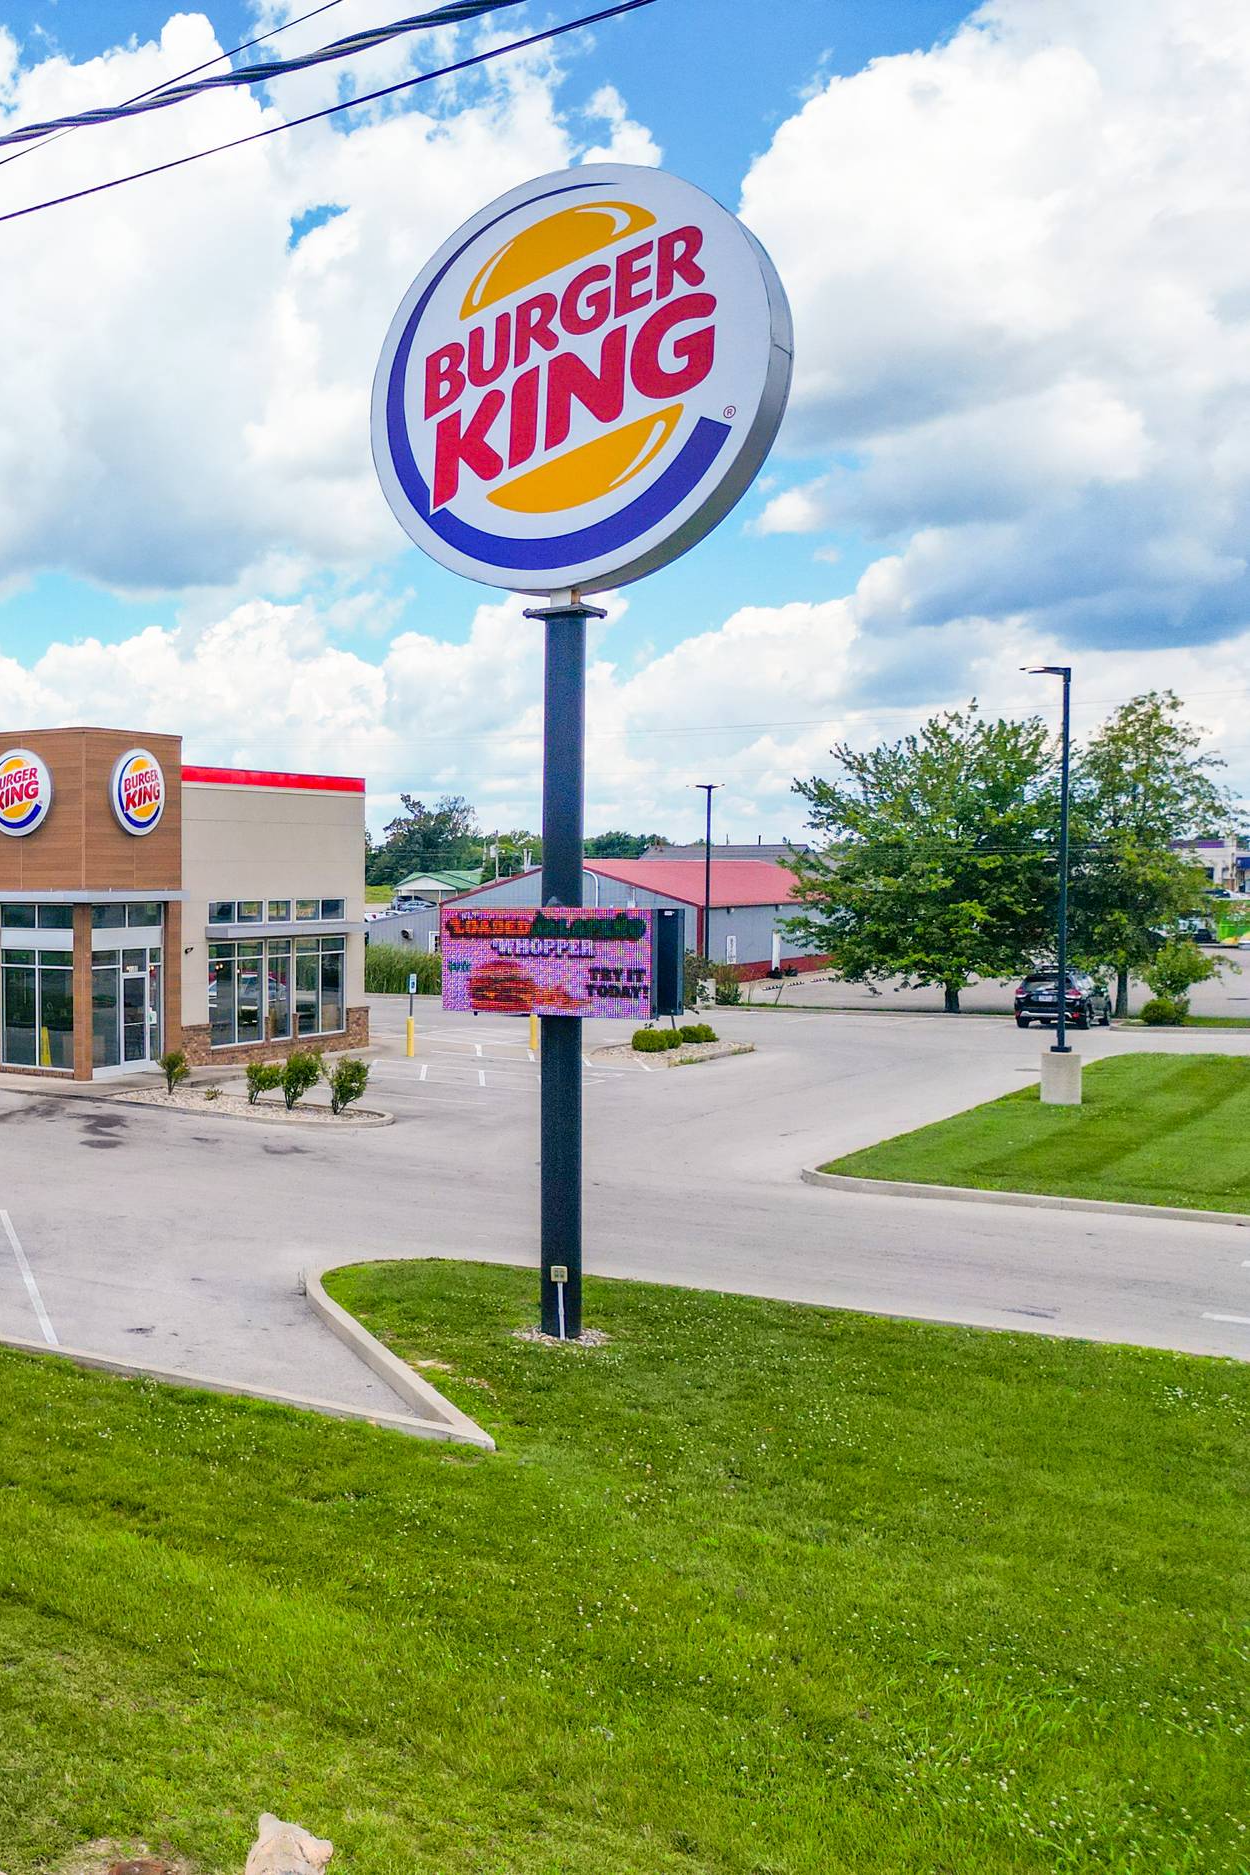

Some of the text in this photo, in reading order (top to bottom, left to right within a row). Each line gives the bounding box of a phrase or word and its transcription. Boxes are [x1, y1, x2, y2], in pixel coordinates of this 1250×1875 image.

[424, 225, 706, 422] BURGER
[432, 293, 717, 511] KING
[124, 769, 159, 792] BURGER
[125, 782, 160, 811] KING
[491, 938, 594, 957] WHOPPER
[588, 967, 647, 982] TRY IT
[585, 984, 649, 999] TODAY!
